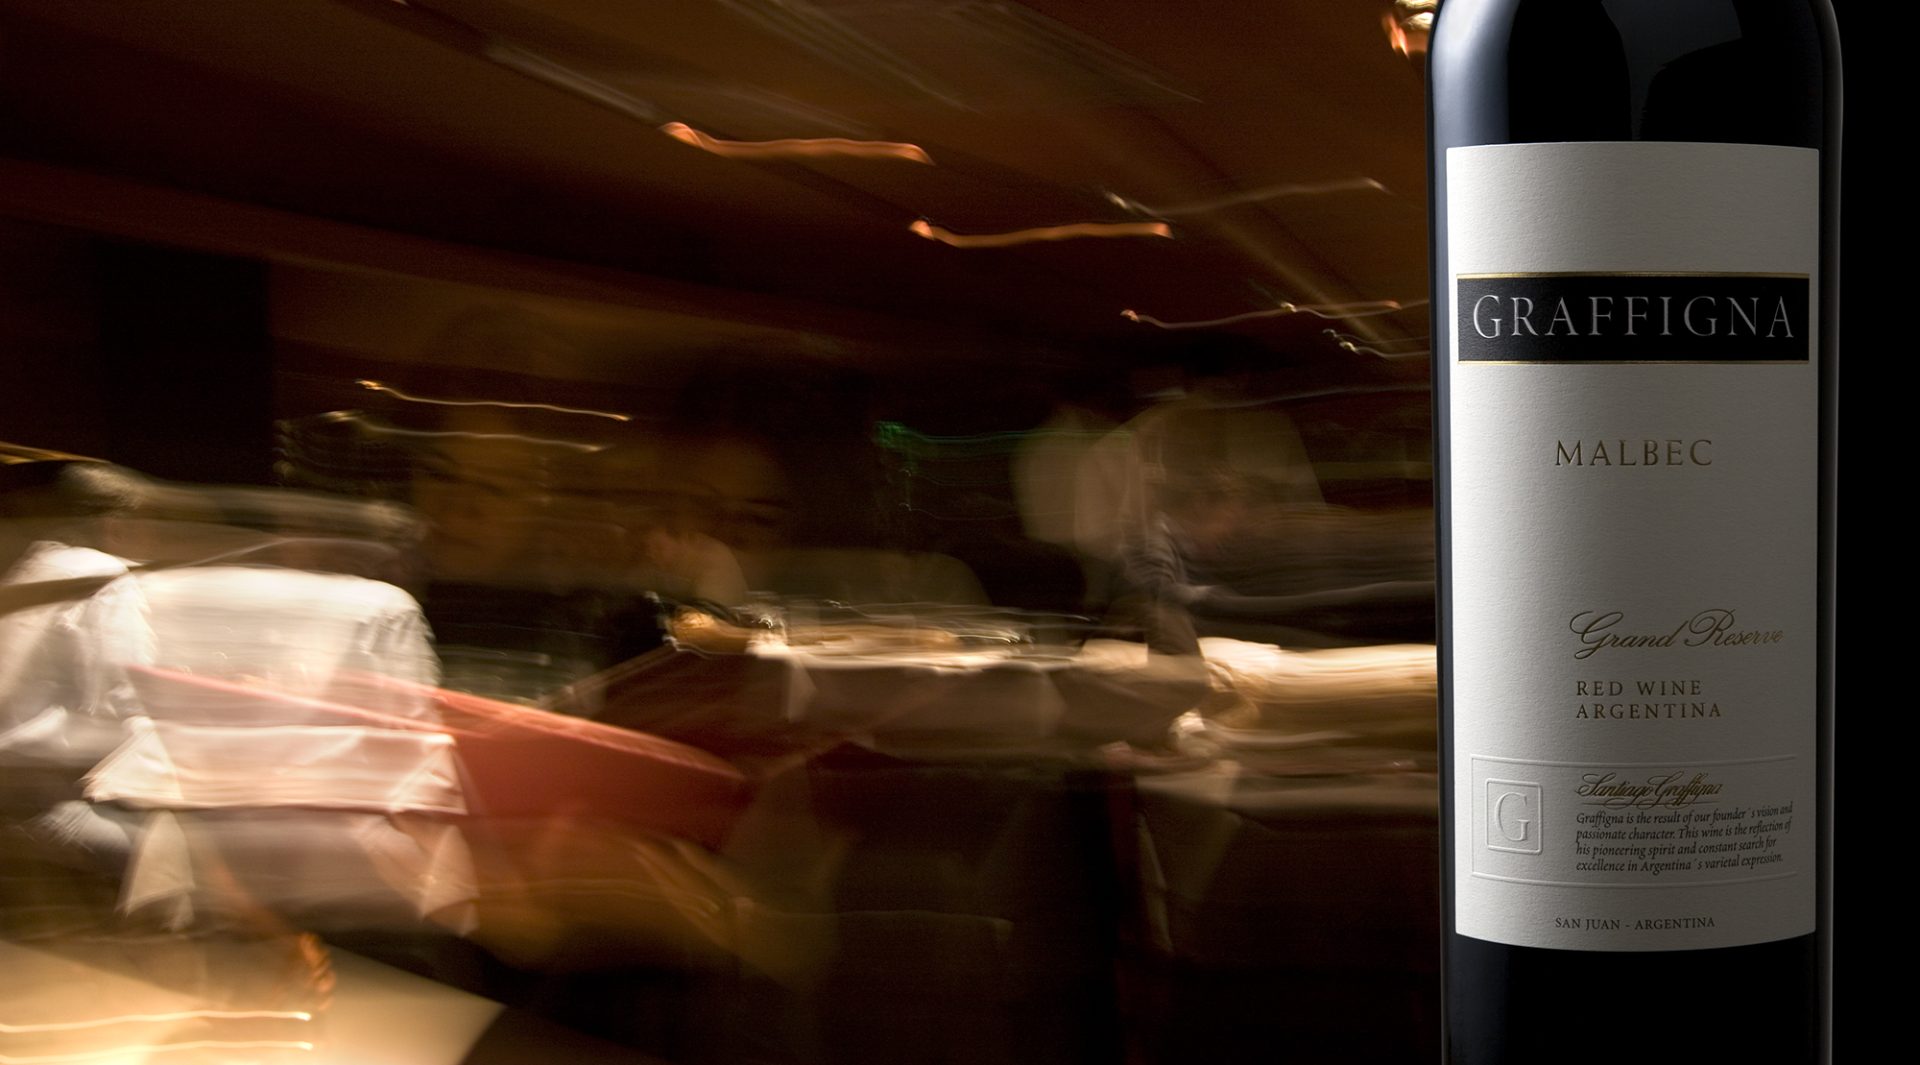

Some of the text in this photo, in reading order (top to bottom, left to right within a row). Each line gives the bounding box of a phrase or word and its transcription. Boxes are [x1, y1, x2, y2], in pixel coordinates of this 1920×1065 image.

[1473, 294, 1794, 339] GRAFFIGNA
[1555, 439, 1713, 467] MALBEC
[1569, 608, 1784, 660] Grand Reserve
[1576, 680, 1702, 697] RED WINE
[1576, 702, 1722, 720] ARGENTINA
[1575, 772, 1654, 810] Santiago
[1494, 791, 1531, 843] G
[1576, 810, 1624, 828] Graffigna
[1626, 812, 1634, 824] is
[1636, 811, 1652, 824] the
[1653, 811, 1681, 824] result
[1682, 809, 1695, 826] of
[1694, 813, 1711, 823] our
[1757, 805, 1779, 817] vision
[1780, 801, 1793, 815] and
[1576, 816, 1793, 843] passionate character. This wine is the reflection of
[1576, 835, 1777, 860] his pioneering spirit and constant search for
[1576, 858, 1625, 871] excellence
[1628, 859, 1638, 872] in
[1705, 853, 1740, 868] varietal
[1741, 850, 1783, 870] expression.
[1555, 917, 1581, 929] SAN
[1586, 918, 1620, 930] JUAN
[1634, 917, 1716, 930] ARGENTINA
